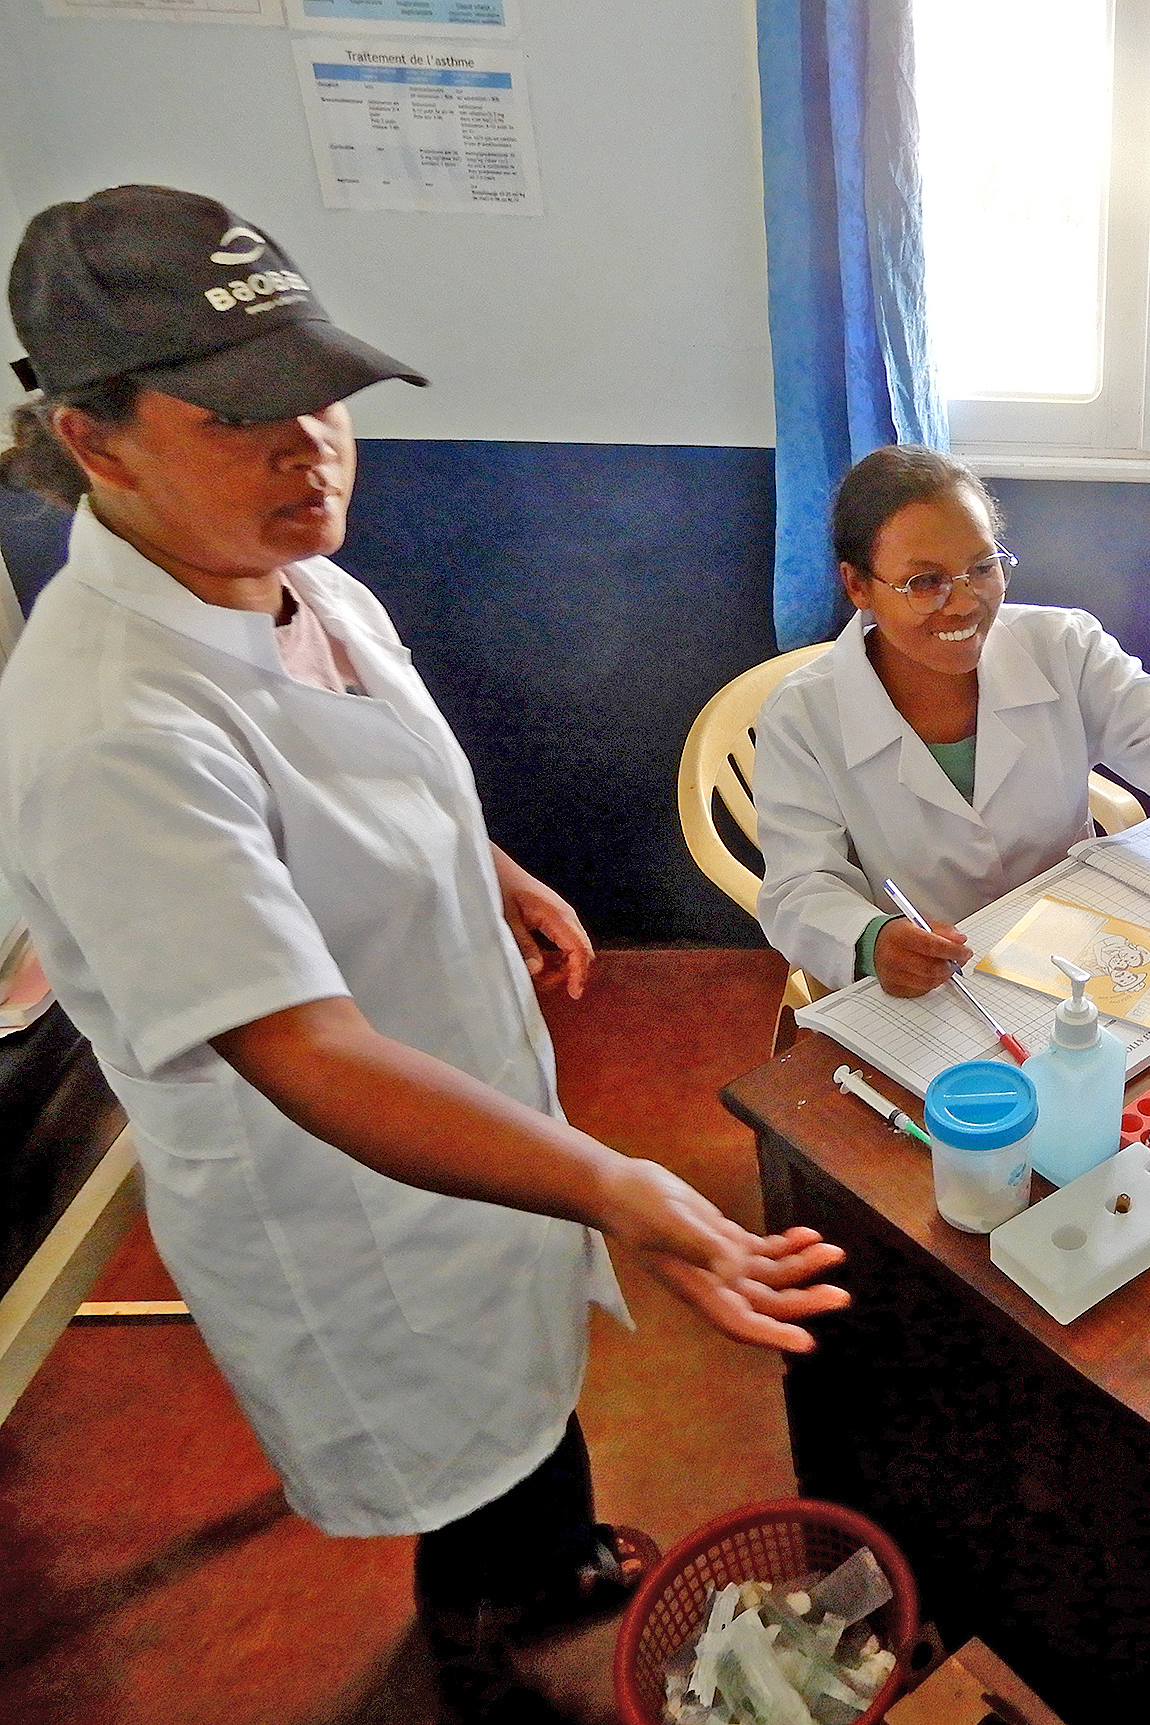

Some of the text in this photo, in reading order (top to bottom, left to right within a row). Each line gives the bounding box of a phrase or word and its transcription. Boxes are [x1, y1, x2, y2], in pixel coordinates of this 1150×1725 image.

[345, 50, 475, 68] Traitement de l'asthme
